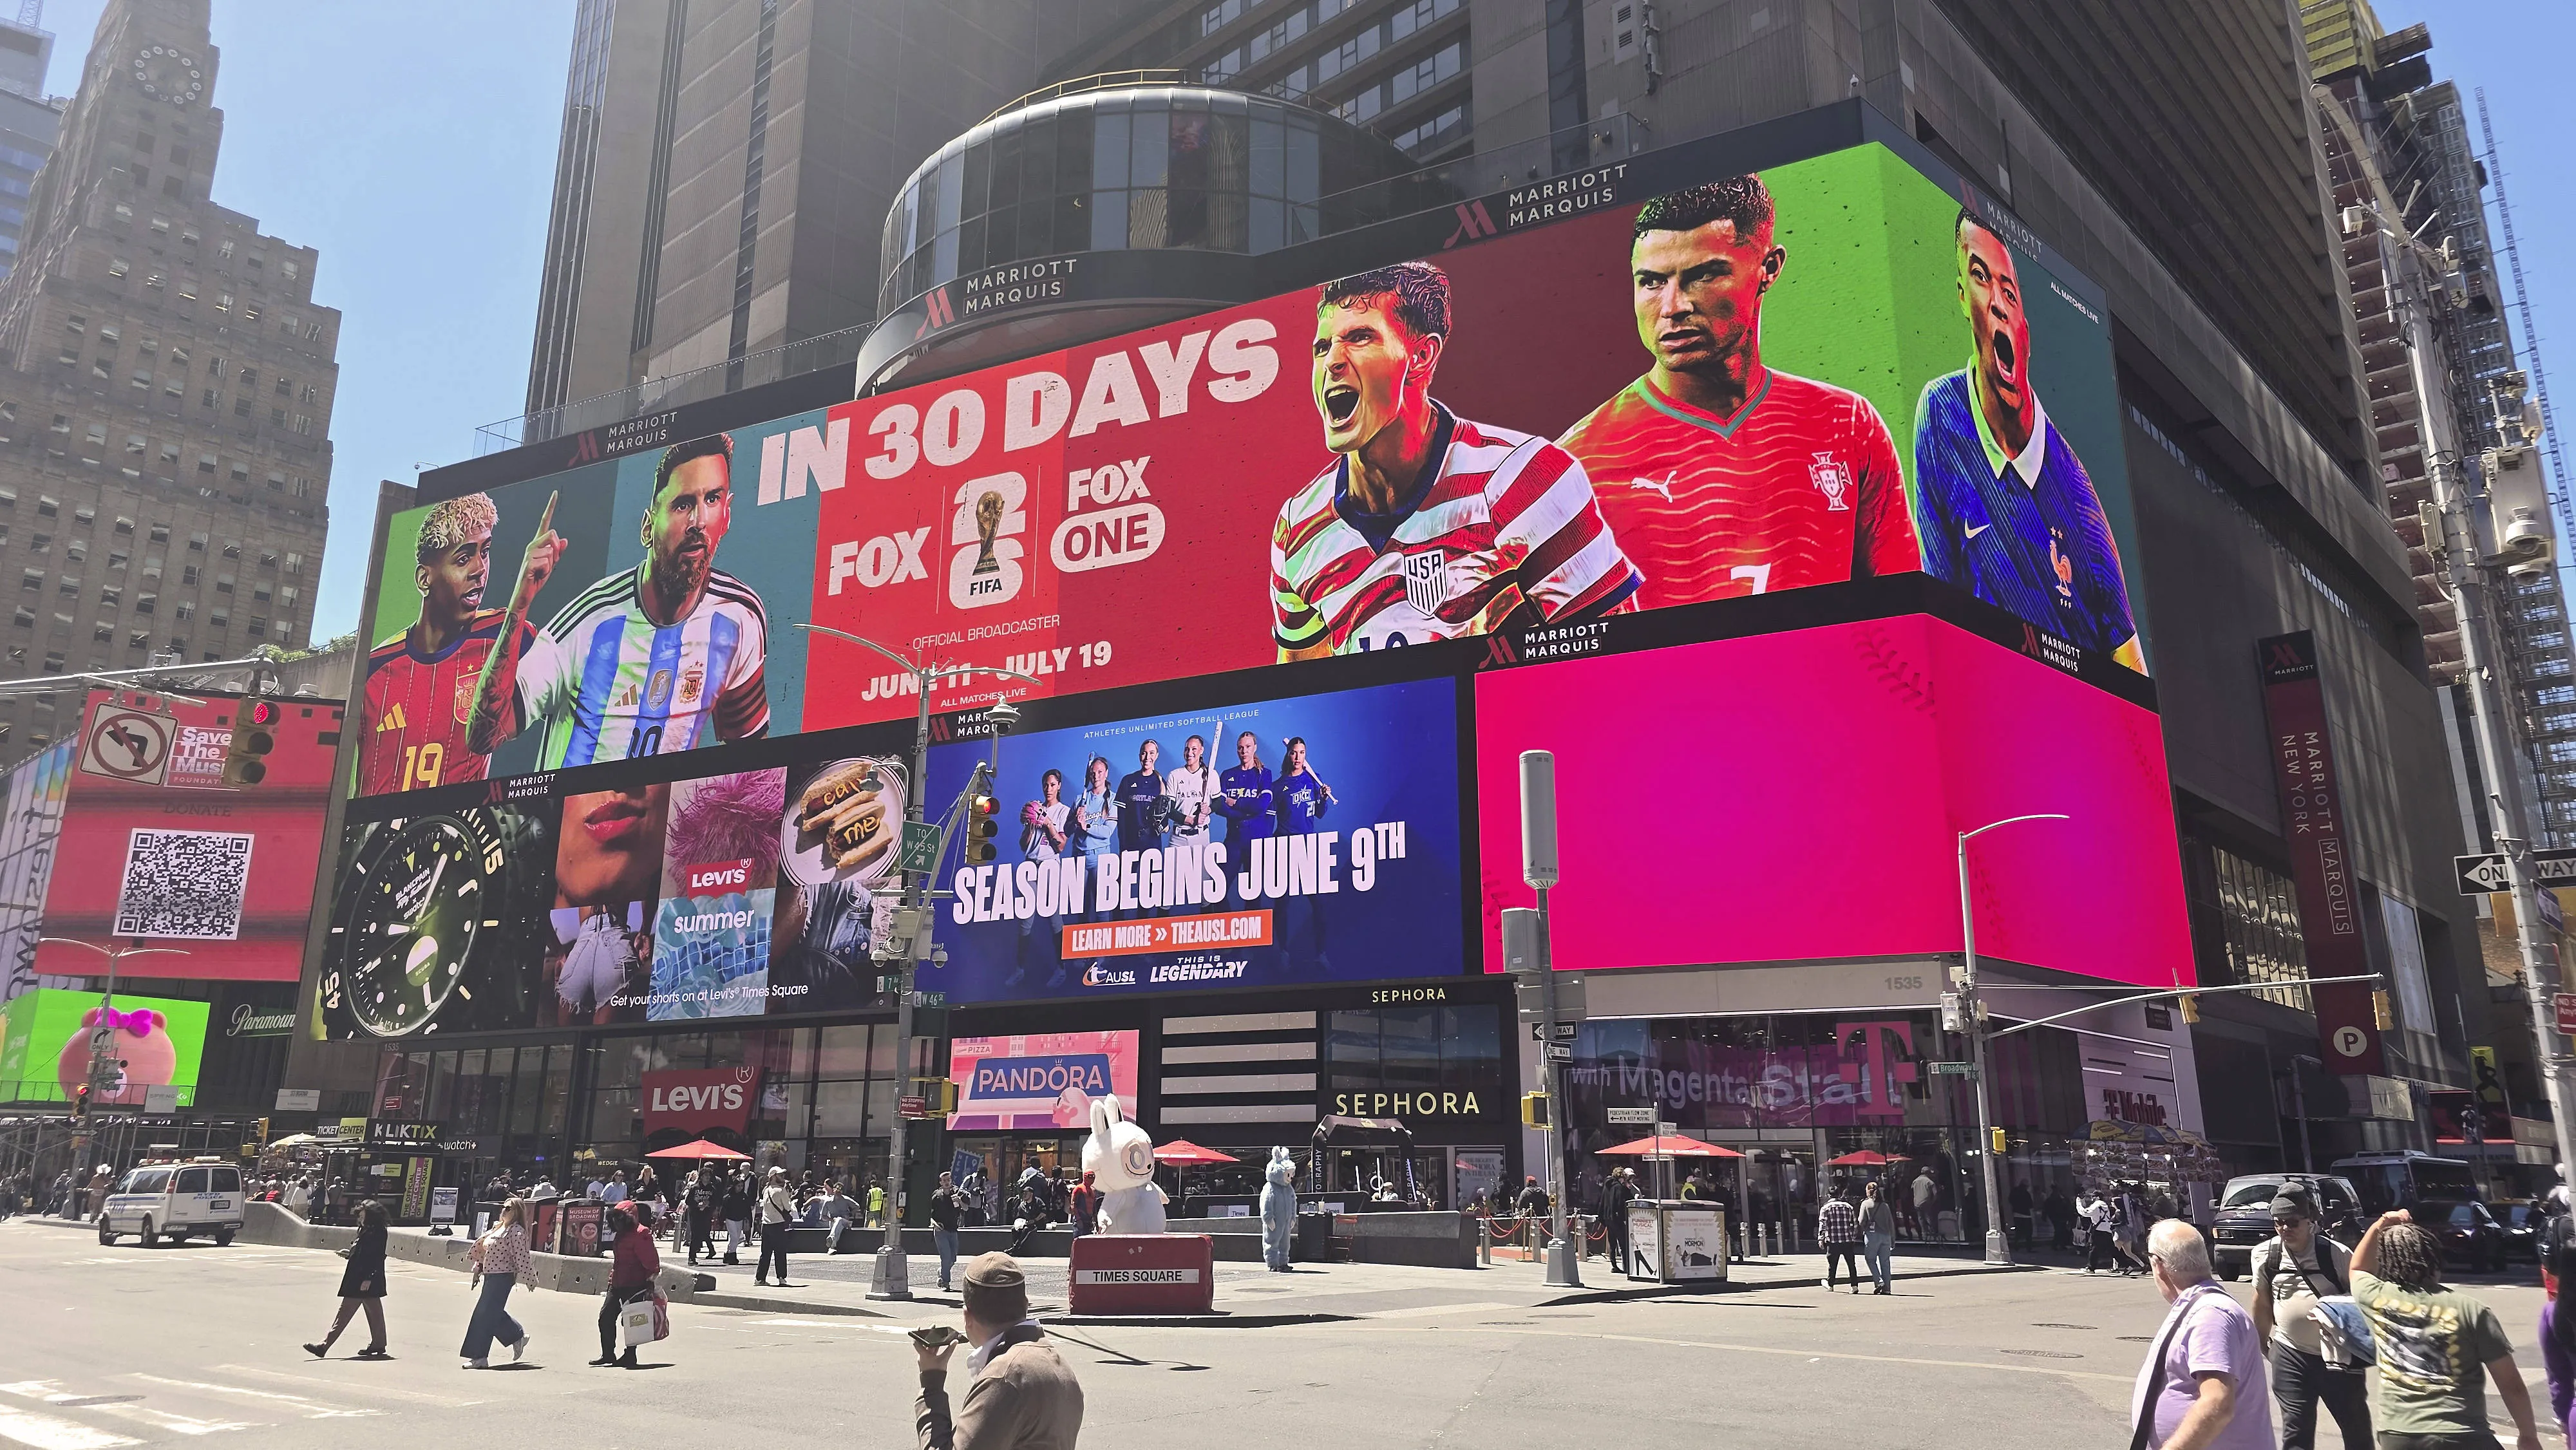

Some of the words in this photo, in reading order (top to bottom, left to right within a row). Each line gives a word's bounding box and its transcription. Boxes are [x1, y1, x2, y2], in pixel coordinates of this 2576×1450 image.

[1509, 164, 1627, 207] MARRIOTT
[1509, 187, 1614, 227] MARQUIS
[1987, 202, 2042, 254] MARRIOTT
[966, 259, 1077, 294] MARRIOTT
[965, 279, 1063, 314] MARQUIS
[608, 411, 679, 438] MARRIOTT
[757, 417, 850, 506] IN
[865, 388, 985, 480] 30
[1003, 318, 1280, 453] DAYS
[607, 428, 667, 453] MARQUIS
[1067, 455, 1151, 512] FOX
[1063, 513, 1149, 561] ONE
[828, 526, 932, 596] FOX
[1406, 551, 1443, 580] USA
[969, 578, 1003, 596] FIFA
[913, 630, 965, 650] OFFICIAL
[967, 614, 1061, 641] BROADCASTER
[1524, 621, 1610, 645] MARRIOTT
[1524, 637, 1600, 659] MARQUIS
[2041, 632, 2081, 661] MARRIOTT
[947, 662, 972, 689] 11
[996, 646, 1072, 681] JULY
[1079, 640, 1113, 668] 19
[2043, 646, 2079, 673] MARQUIS
[2275, 664, 2315, 676] MARRIOTT
[940, 697, 959, 708] ALL
[960, 691, 1004, 706] MATCHES
[1005, 687, 1027, 698] LIVE
[957, 722, 996, 737] MARQU
[958, 711, 990, 724] MARR
[1084, 729, 1126, 739] ATHLETES
[1128, 722, 1175, 735] UNLIMITED
[1177, 715, 1222, 729] SOFTBALL
[1224, 709, 1260, 723] LEAGUE
[182, 727, 232, 746] Save
[625, 725, 664, 759] 10
[180, 740, 220, 759] The
[2282, 734, 2302, 775] NEW
[403, 742, 444, 791] 19
[174, 777, 222, 785] FOUNDAT
[507, 785, 549, 799] MARQUIS
[509, 773, 556, 787] MARRIOTT
[1226, 787, 1258, 798] TEXAS
[2291, 782, 2311, 835] YORK
[844, 816, 881, 845] me
[916, 828, 927, 838] TO
[2304, 731, 2334, 833] MARRIOTT
[2321, 842, 2351, 932] MARQUIS
[907, 840, 913, 850] W
[927, 843, 935, 853] St
[952, 854, 1087, 925] SEASON
[1094, 839, 1228, 912] BEGINS
[1237, 831, 1339, 901] JUNE
[2538, 860, 2576, 877] WAY
[395, 867, 431, 902] BLANCPAIN
[674, 909, 755, 934] summer
[1072, 927, 1112, 952] LEARN
[1114, 924, 1151, 948] MORE
[1171, 916, 1262, 945] THEAUSL.COM
[887, 977, 893, 989] 7
[1105, 970, 1136, 983] AUSL
[1150, 960, 1248, 983] LEGENDARY
[1884, 975, 1922, 990] 1535
[325, 972, 341, 1010] 45
[610, 995, 629, 1006] Get
[629, 994, 651, 1008] your
[652, 992, 680, 1005] shorts
[683, 993, 696, 1003] on
[697, 991, 708, 1002] at
[742, 985, 770, 999] Times
[772, 983, 809, 999] Square
[922, 993, 928, 1004] W
[929, 995, 938, 1006] 46
[1372, 988, 1446, 1003] SEPHORA
[227, 1004, 296, 1037] Paramoun
[1557, 1026, 1571, 1035] WAY
[91, 1043, 110, 1051] ONLY
[1558, 1048, 1569, 1056] WAY
[2343, 1032, 2358, 1053] P
[978, 1061, 1104, 1093] PANDORA
[1940, 1063, 1973, 1072] Broadway
[1618, 1055, 1751, 1109] Magenta
[1336, 1091, 1480, 1116] SEPHORA
[317, 1125, 339, 1135] TICKET
[339, 1125, 365, 1135] CENTER
[405, 1172, 414, 1203] OFFICIAL
[1093, 1270, 1130, 1282] TIMES
[1133, 1269, 1183, 1283] SQUARE
